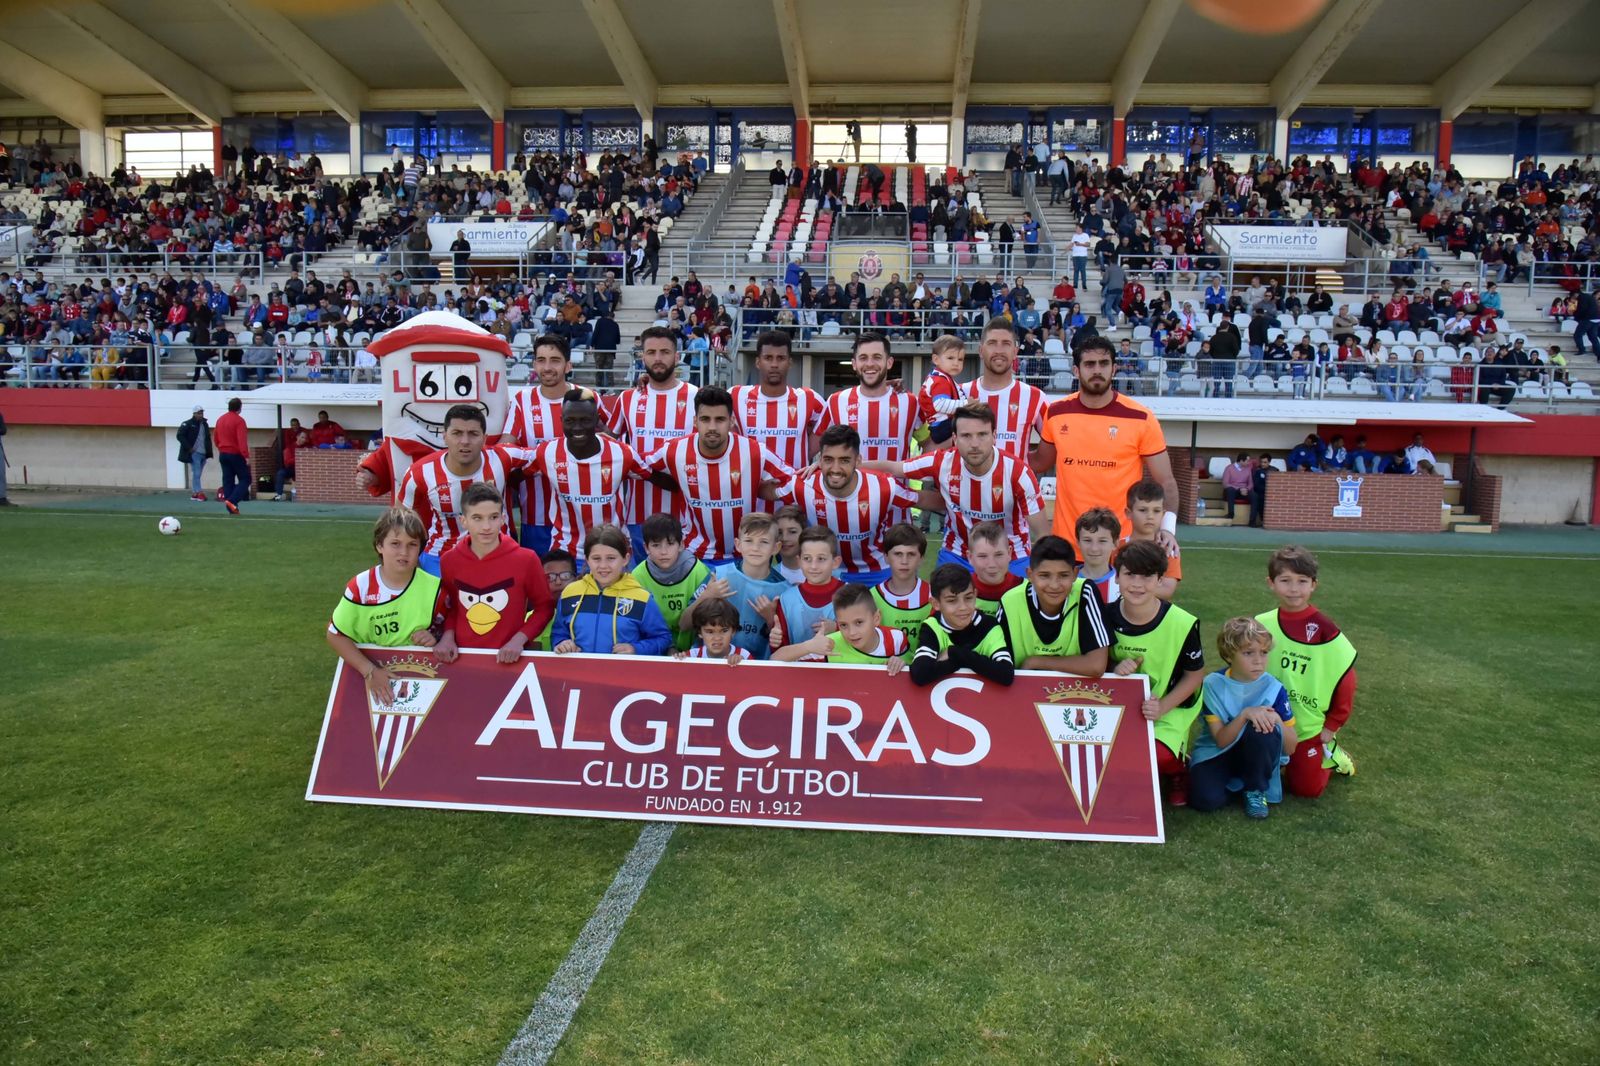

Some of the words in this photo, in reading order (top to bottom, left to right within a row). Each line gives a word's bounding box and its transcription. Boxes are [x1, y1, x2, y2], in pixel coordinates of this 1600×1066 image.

[1240, 231, 1318, 245] Sarmiento
[393, 369, 410, 393] L
[485, 370, 500, 393] V
[648, 429, 686, 438] HYUNDAI
[995, 432, 1017, 441] NDAI
[1077, 459, 1117, 468] HYUNDAI
[704, 499, 744, 508] HYUNDAI
[964, 510, 1006, 520] HYUNDAI
[668, 600, 683, 611] 09
[374, 621, 400, 637] 013
[1281, 656, 1307, 675] 011
[475, 662, 992, 767] ALGECIRAS
[583, 760, 669, 789] CLUB
[682, 765, 724, 792] DE
[737, 761, 871, 798] FÚTBOL
[646, 795, 725, 813] FUNDADO
[731, 799, 751, 814] EN
[758, 800, 802, 816] 1.912
